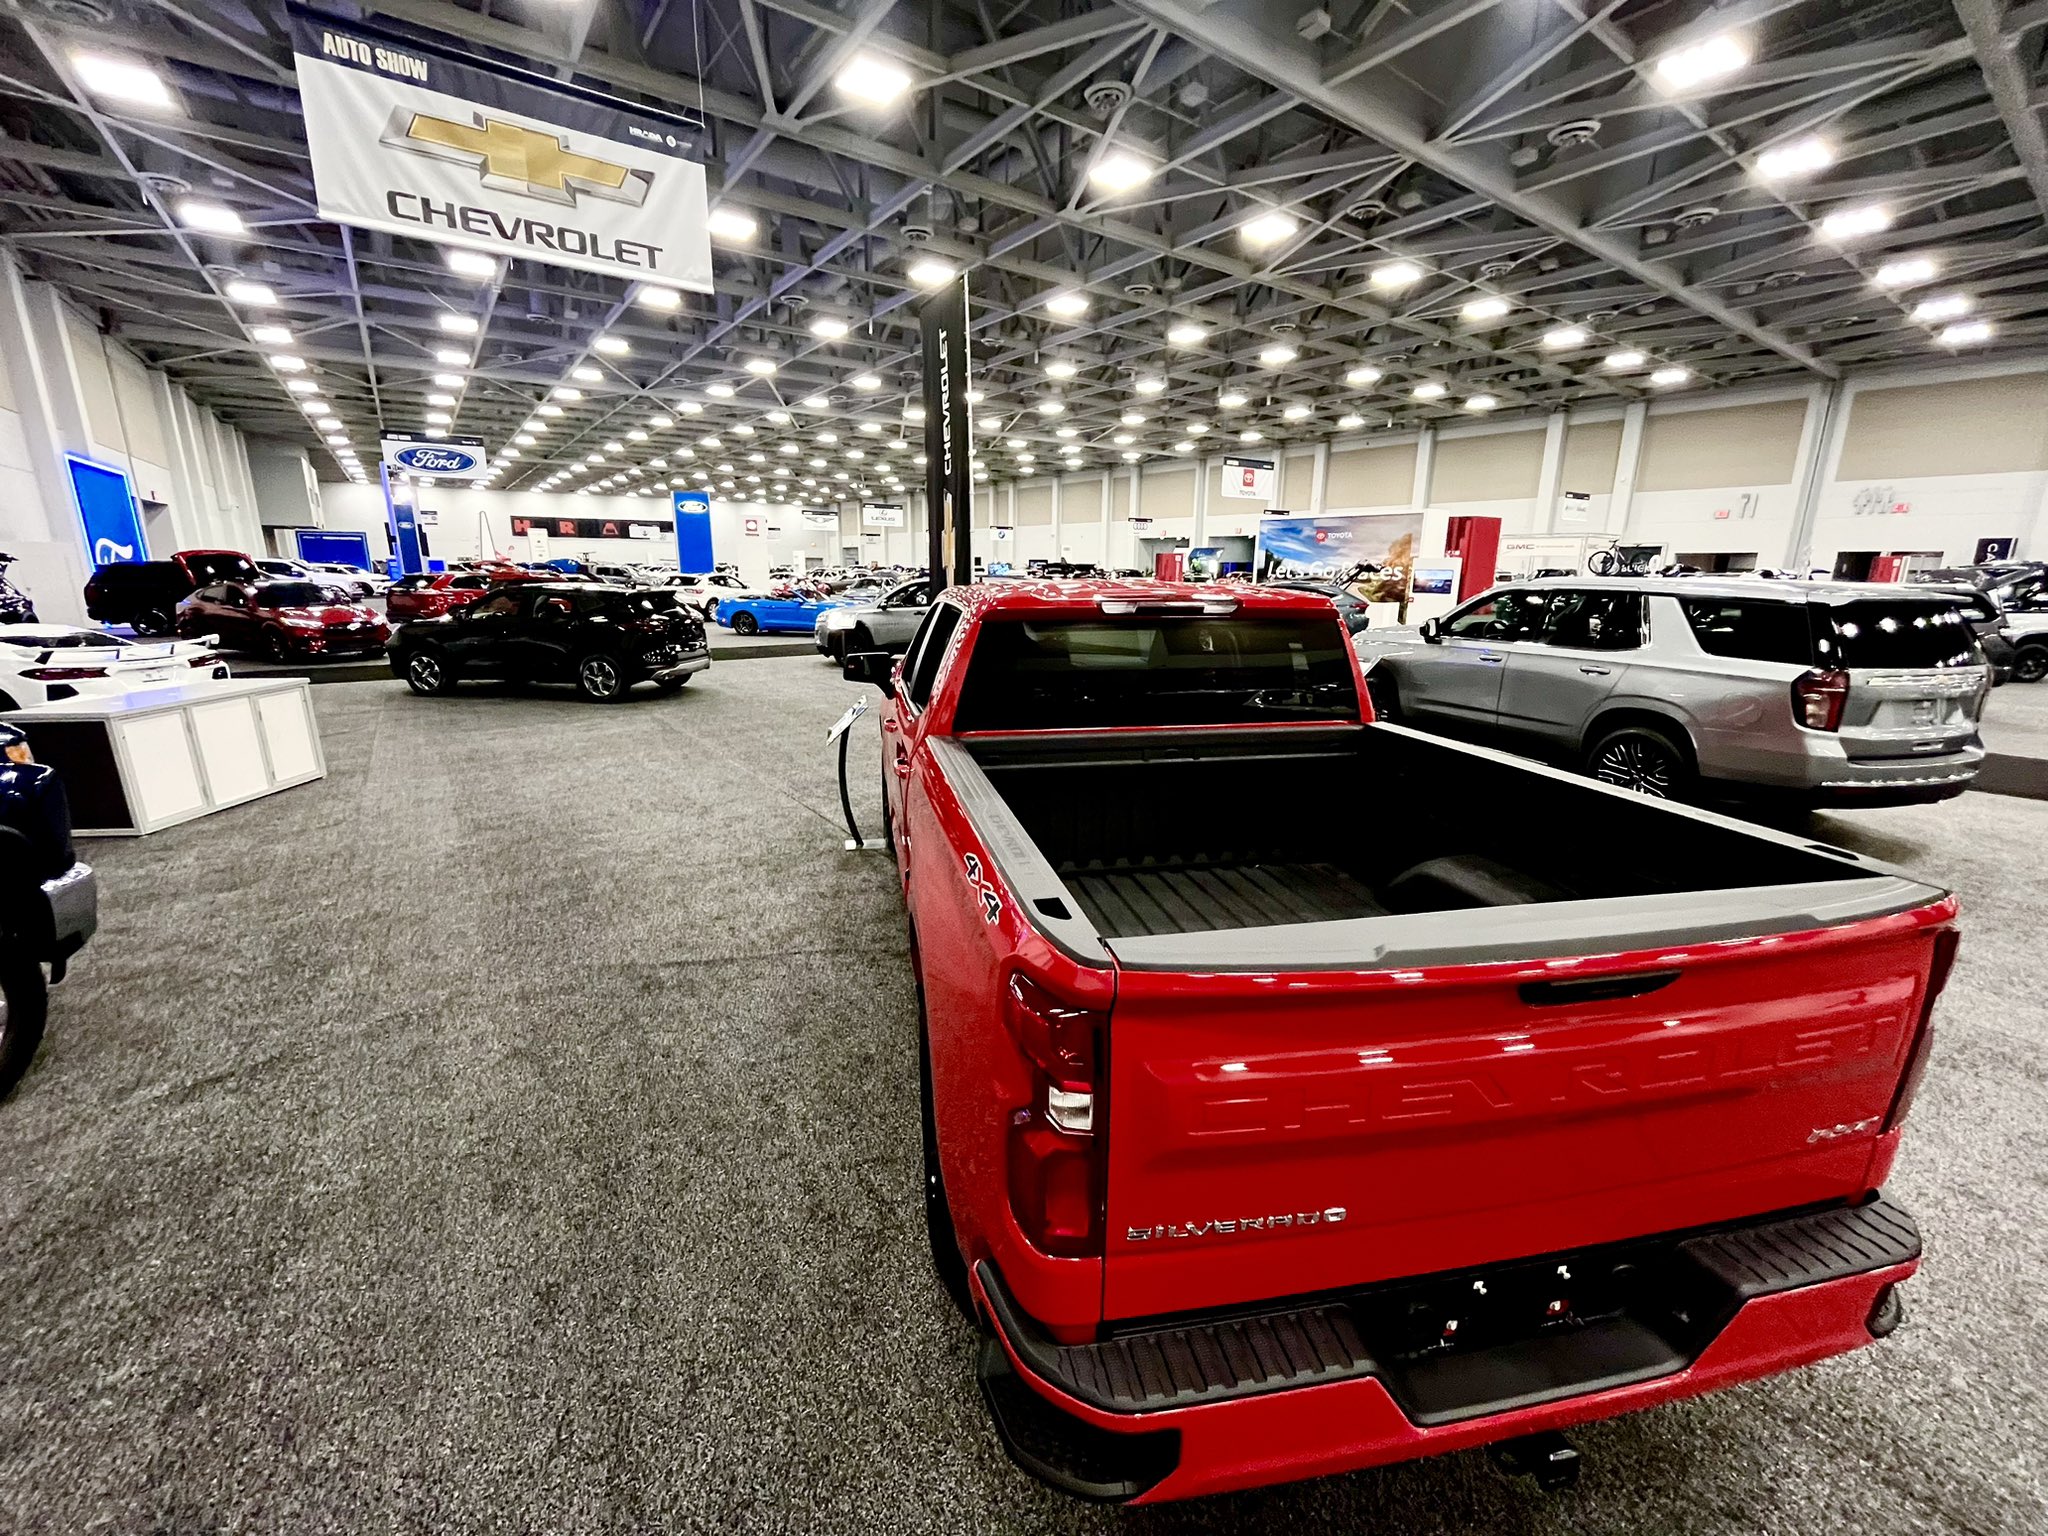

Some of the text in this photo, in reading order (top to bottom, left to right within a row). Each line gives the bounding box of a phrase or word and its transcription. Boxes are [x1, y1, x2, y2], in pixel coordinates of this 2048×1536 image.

[323, 31, 428, 82] AUTO SHOW
[386, 190, 663, 269] CHEVROLET
[939, 328, 952, 475] CHEVROLET
[411, 449, 461, 470] Ford
[1327, 531, 1353, 539] TOYOTA
[1310, 560, 1336, 579] Go
[1187, 1012, 1899, 1136] CHEVROLET
[1126, 1207, 1347, 1241] SILVERADO
